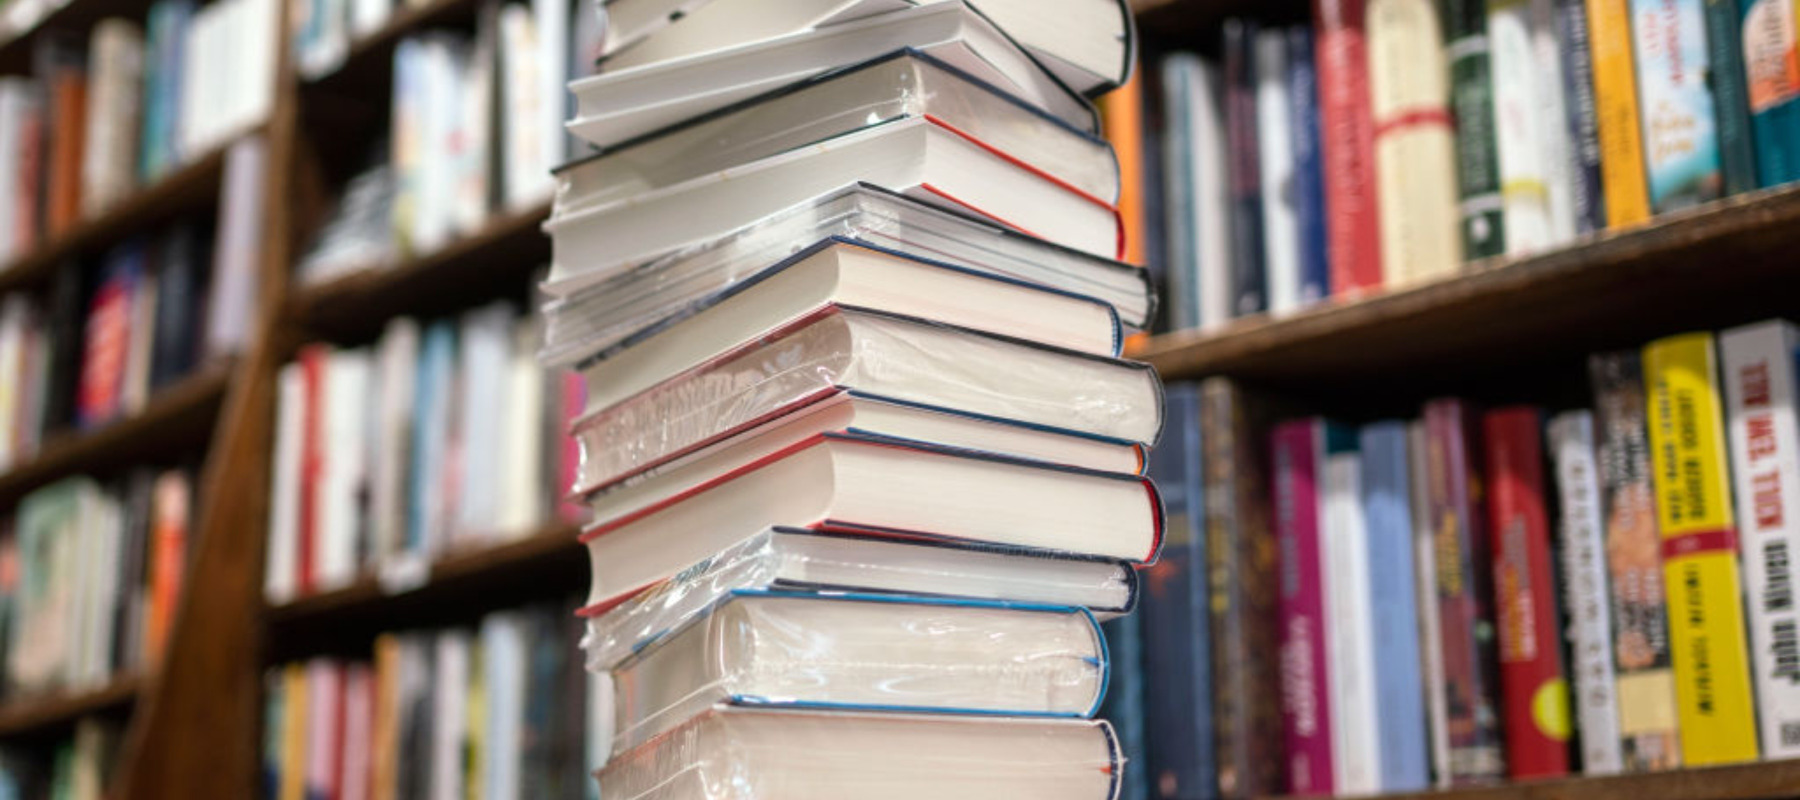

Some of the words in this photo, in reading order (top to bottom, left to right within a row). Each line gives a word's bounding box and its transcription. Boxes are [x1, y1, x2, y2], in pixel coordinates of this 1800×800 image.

[1739, 358, 1772, 408] ALL
[1752, 469, 1783, 531] KILL
[1764, 541, 1793, 613] Niven
[1771, 621, 1800, 685] John
